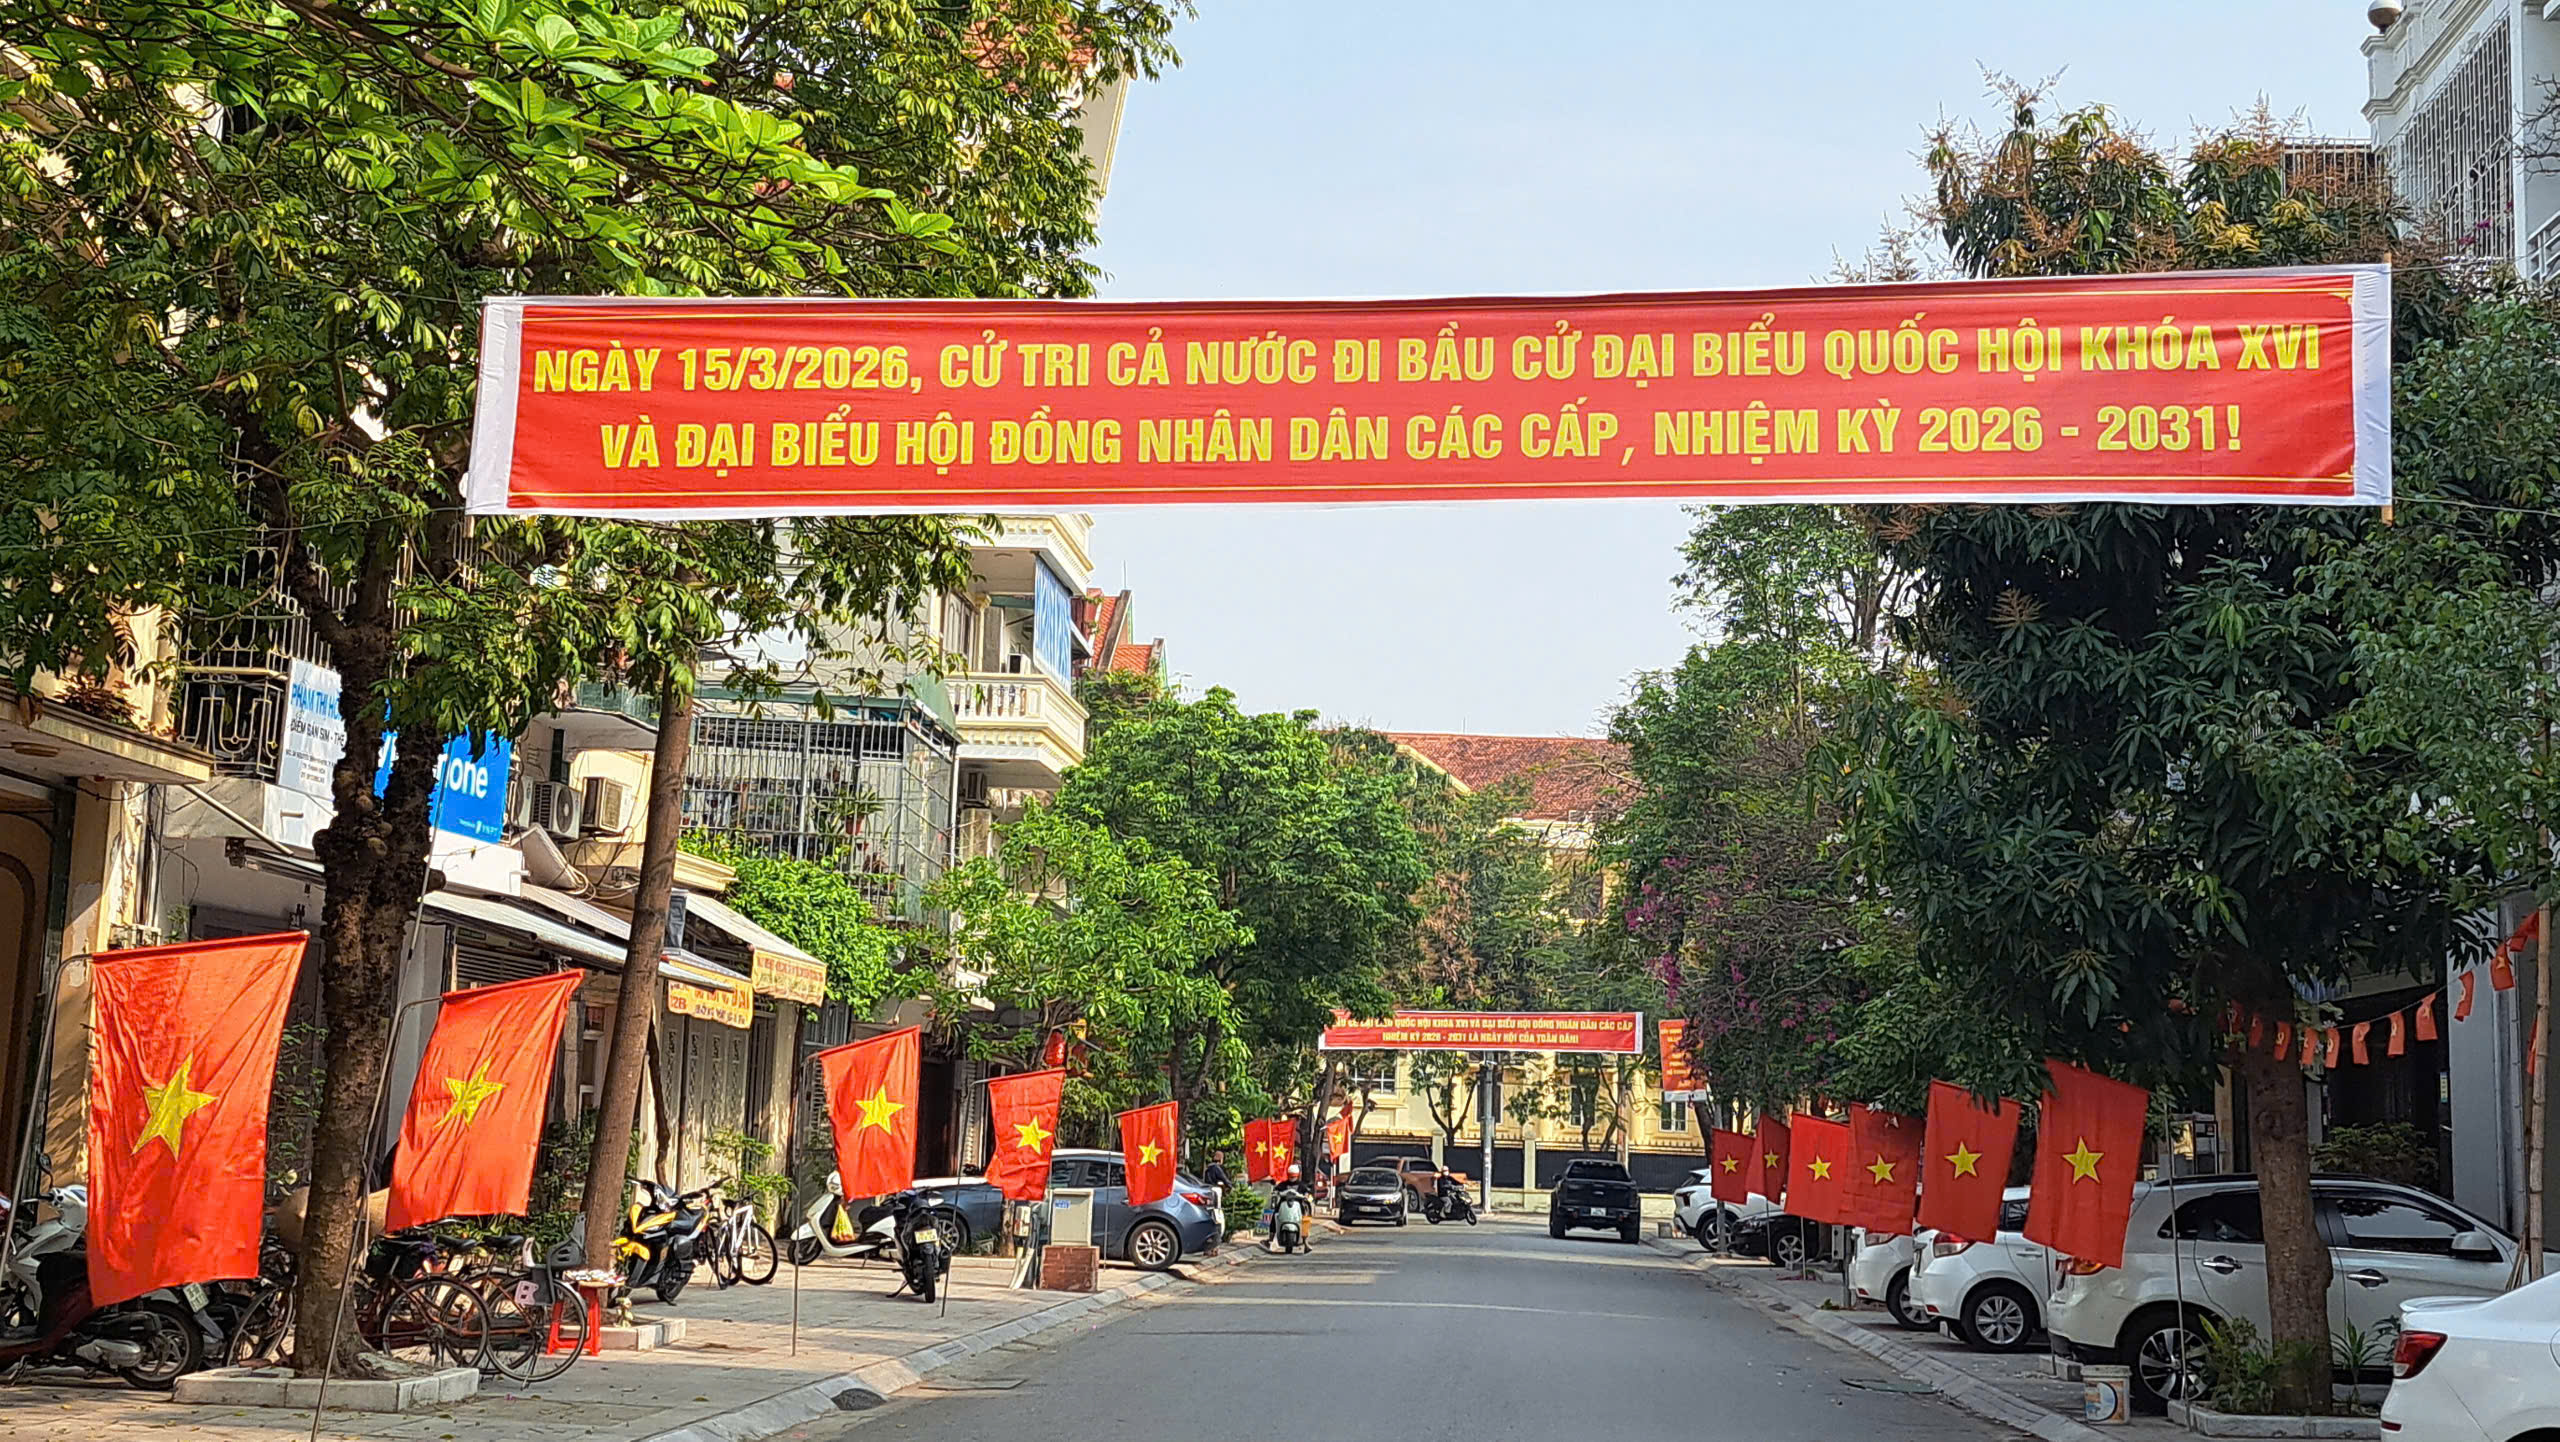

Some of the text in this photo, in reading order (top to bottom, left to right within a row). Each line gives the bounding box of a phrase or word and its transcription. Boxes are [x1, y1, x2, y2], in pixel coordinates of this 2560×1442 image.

[534, 312, 2320, 395] NGÀY 15/3/2026, CỬ TRI CẢ NƯỚC ĐI BẦU CỬ ĐẠI BIỂU QUỐC HỘI KHÓA XVI
[600, 415, 660, 469] VÀ
[675, 422, 754, 477] ĐẠI
[771, 404, 878, 466] BIỂU
[895, 411, 974, 475] HỘI
[990, 405, 1121, 464] ĐỒNG
[1138, 409, 1272, 463] NHÂN
[1290, 407, 1388, 460] DÂN
[1406, 405, 1502, 460] CÁC
[1654, 400, 1826, 464] NHIỆM
[1837, 399, 1900, 453] KỲ
[1918, 405, 2041, 452] 2026
[2060, 427, 2079, 437] -
[2097, 404, 2240, 451] 2031!
